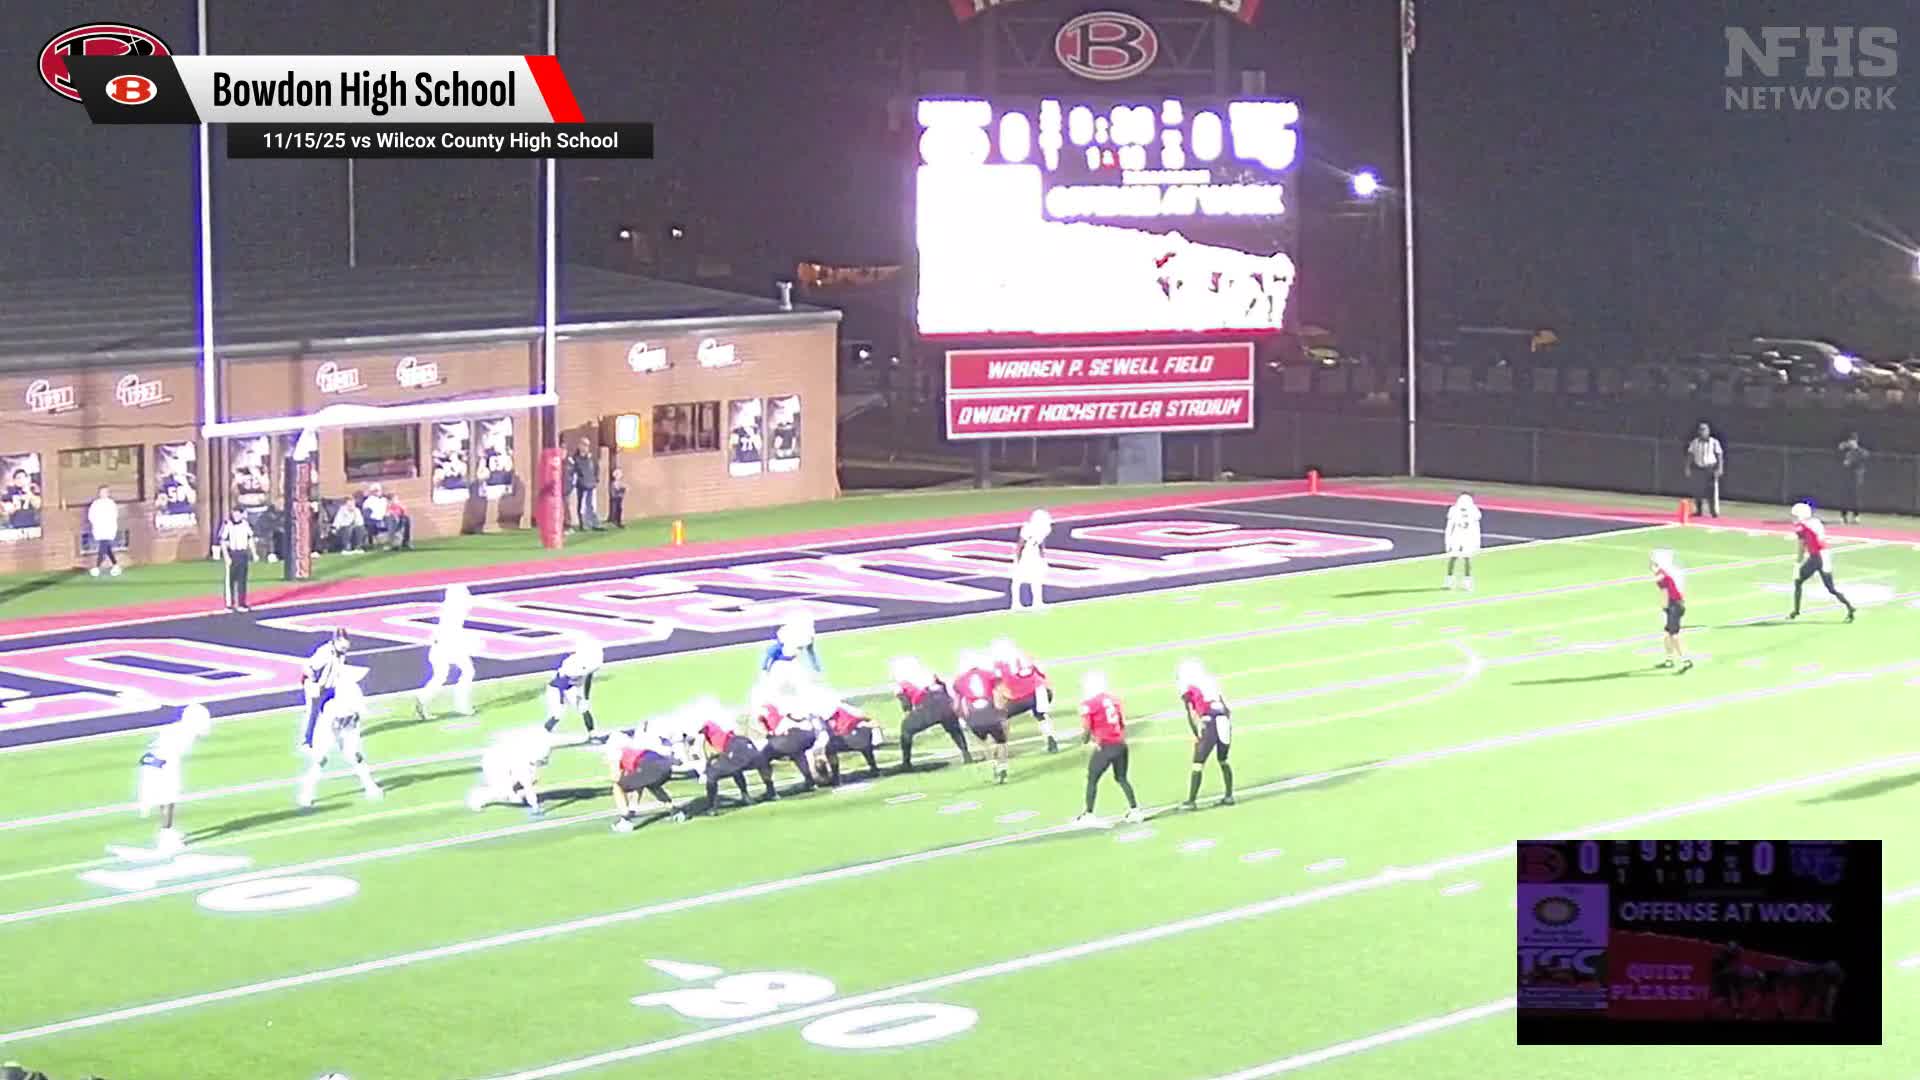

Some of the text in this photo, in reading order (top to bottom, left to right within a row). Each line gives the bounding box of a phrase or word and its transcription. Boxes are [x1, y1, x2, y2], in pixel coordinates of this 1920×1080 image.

[988, 359, 1065, 379] WARREN
[1088, 357, 1159, 377] SEWELL
[1164, 355, 1215, 374] FIELD
[958, 397, 1242, 425] DWIGHT HOCHSTETLER STADIUM
[1579, 841, 1599, 874] 0
[1754, 841, 1775, 876] 0
[1619, 902, 1832, 923] OFFENSE AT WORK
